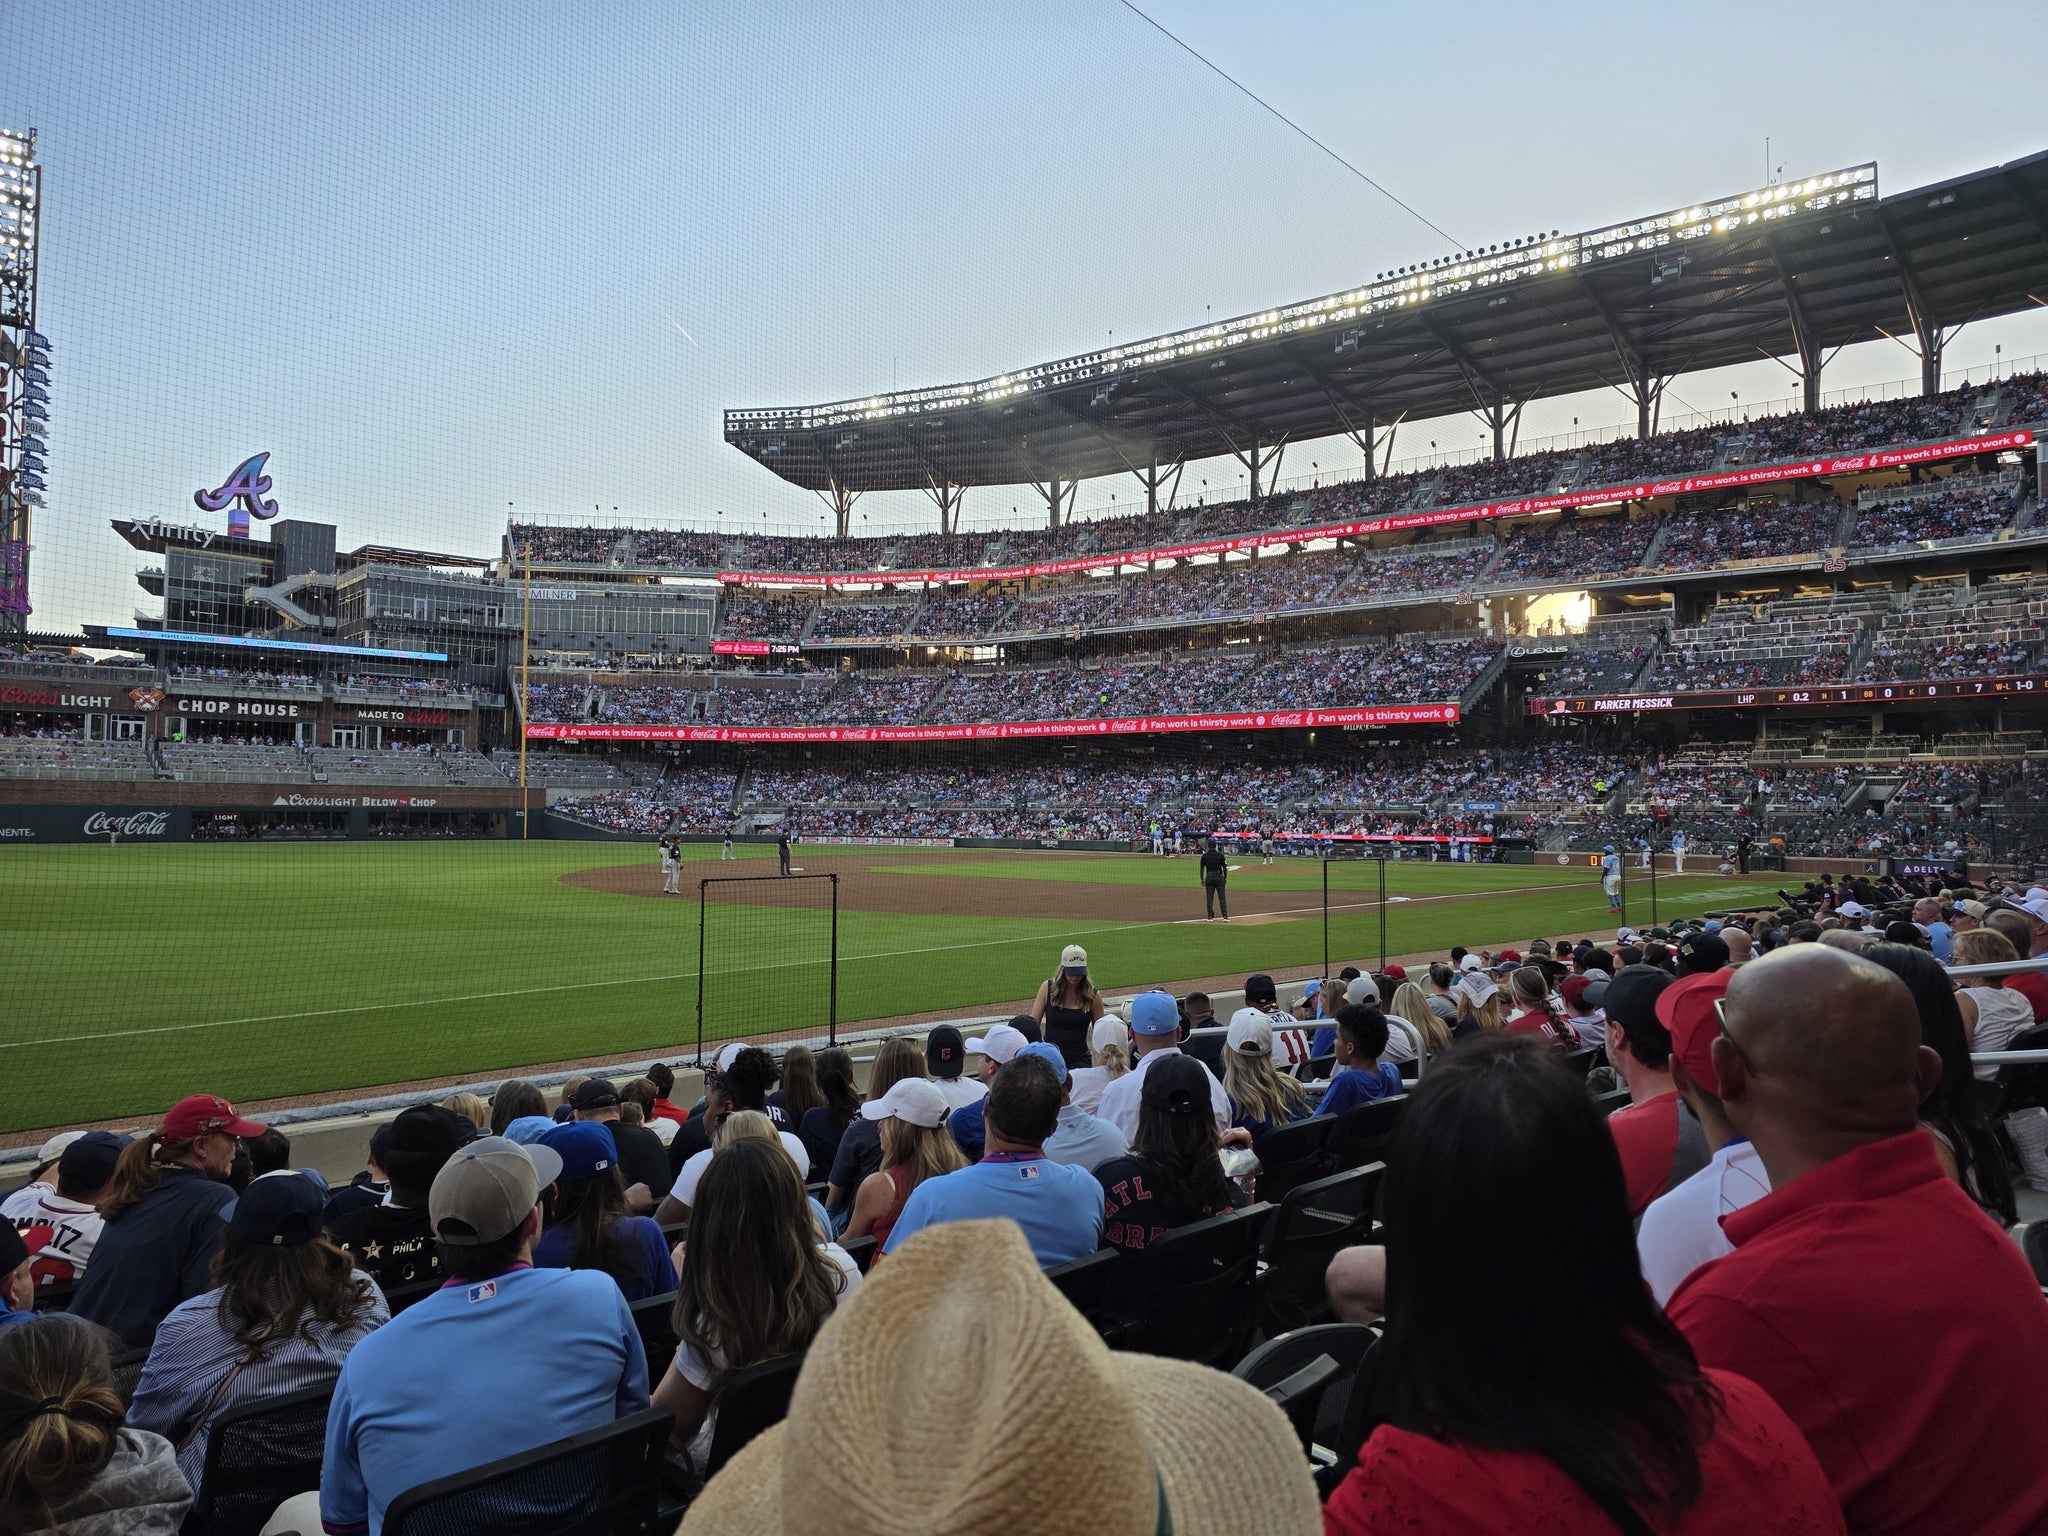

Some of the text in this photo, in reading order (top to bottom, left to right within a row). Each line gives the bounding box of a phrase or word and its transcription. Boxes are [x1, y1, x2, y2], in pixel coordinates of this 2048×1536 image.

[28, 369, 45, 379] 2001
[26, 404, 45, 416] 2005
[26, 422, 43, 433] 2012
[1904, 450, 1930, 460] work
[1944, 444, 1980, 454] thirsty
[1982, 438, 2010, 448] work
[24, 456, 43, 469] 2020
[23, 474, 42, 486] 2022
[1714, 476, 1738, 484] work
[1750, 470, 1782, 480] thirsty
[1784, 466, 1810, 476] work
[23, 491, 41, 502] 2024
[1550, 498, 1572, 506] work
[1582, 494, 1608, 502] thirsty
[1610, 490, 1632, 498] work
[1408, 516, 1426, 524] work
[1460, 510, 1480, 518] work
[130, 515, 216, 548] xfinity
[1824, 557, 1846, 572] 25
[531, 590, 575, 600] MILNER
[772, 645, 787, 653] 7:25
[788, 646, 800, 654] PM
[1526, 646, 1568, 654] LEXUS
[1928, 686, 1936, 695] 0
[1975, 684, 1982, 692] 7
[2016, 680, 2033, 690] 1-0
[0, 687, 112, 708] Coors LIGHT
[1793, 692, 1809, 702] 0.2
[1841, 691, 1847, 700] 1
[1884, 688, 1892, 697] 0
[178, 700, 299, 716] CHOP HOUSE
[1576, 695, 1755, 710] 77 PARKER MESSICK LHP
[358, 710, 388, 720] MADE
[391, 712, 404, 720] TO
[1318, 714, 1336, 722] Fan
[1338, 712, 1364, 722] work
[1366, 712, 1374, 720] is
[1376, 710, 1410, 720] thirsty
[1412, 710, 1440, 718] work
[1168, 720, 1190, 728] work
[1198, 718, 1228, 728] thirsty
[1230, 718, 1254, 726] work
[622, 730, 650, 738] thirsty
[924, 730, 946, 738] thirsty
[1024, 726, 1042, 734] work
[1050, 724, 1072, 732] thirsty
[1074, 724, 1096, 732] work
[780, 732, 806, 740] thirsty
[288, 794, 356, 806] Coors LIGHT
[362, 797, 437, 807] BELOW CHOP
[84, 811, 171, 835] Coca-Cola
[1280, 1030, 1307, 1064] 11
[766, 1106, 786, 1122] JR.
